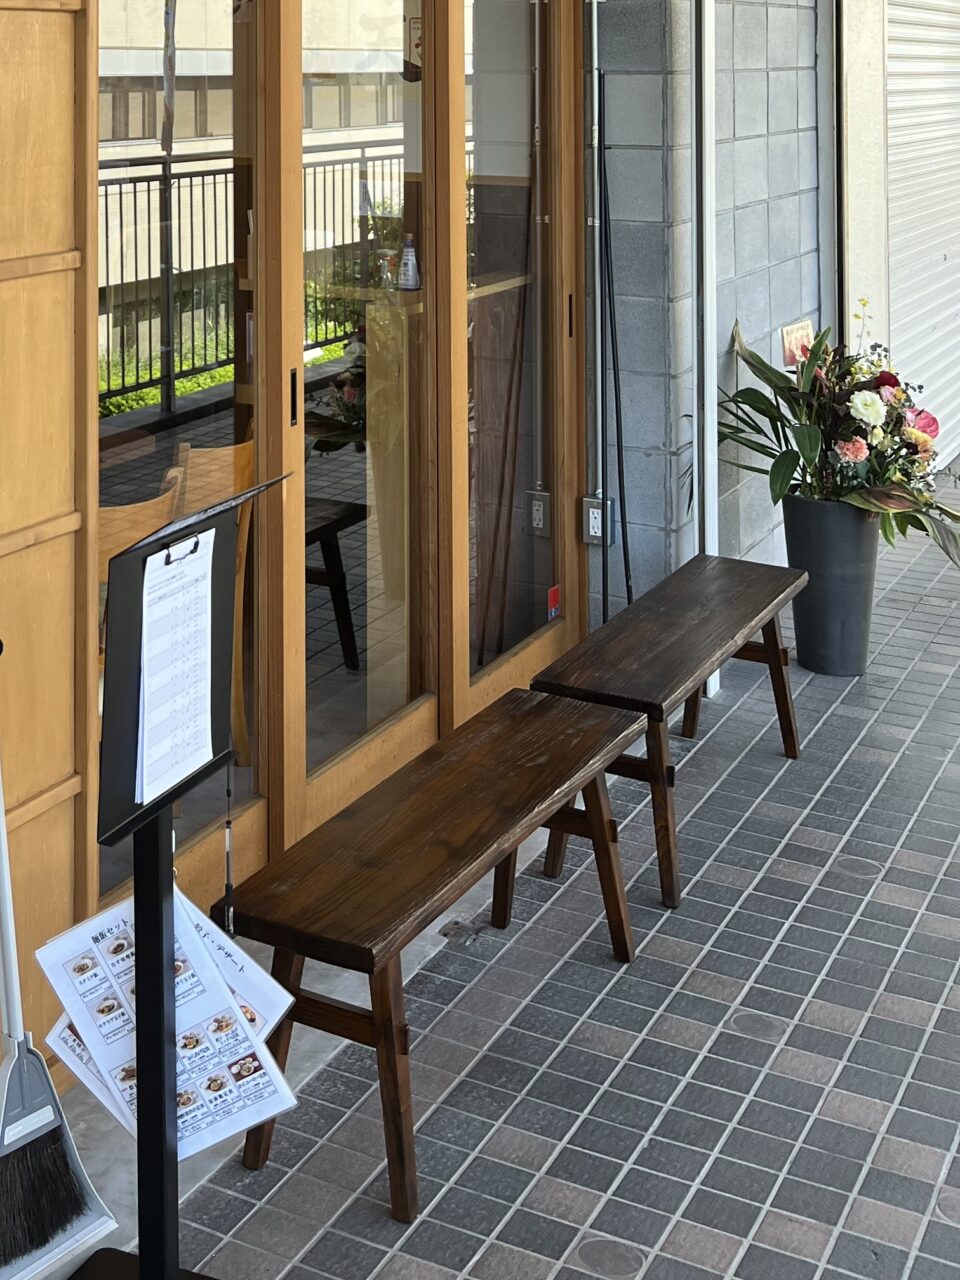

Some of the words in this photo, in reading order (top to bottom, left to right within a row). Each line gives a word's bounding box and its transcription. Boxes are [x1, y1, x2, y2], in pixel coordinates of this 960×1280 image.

[91, 918, 129, 945] 麺飯セット
